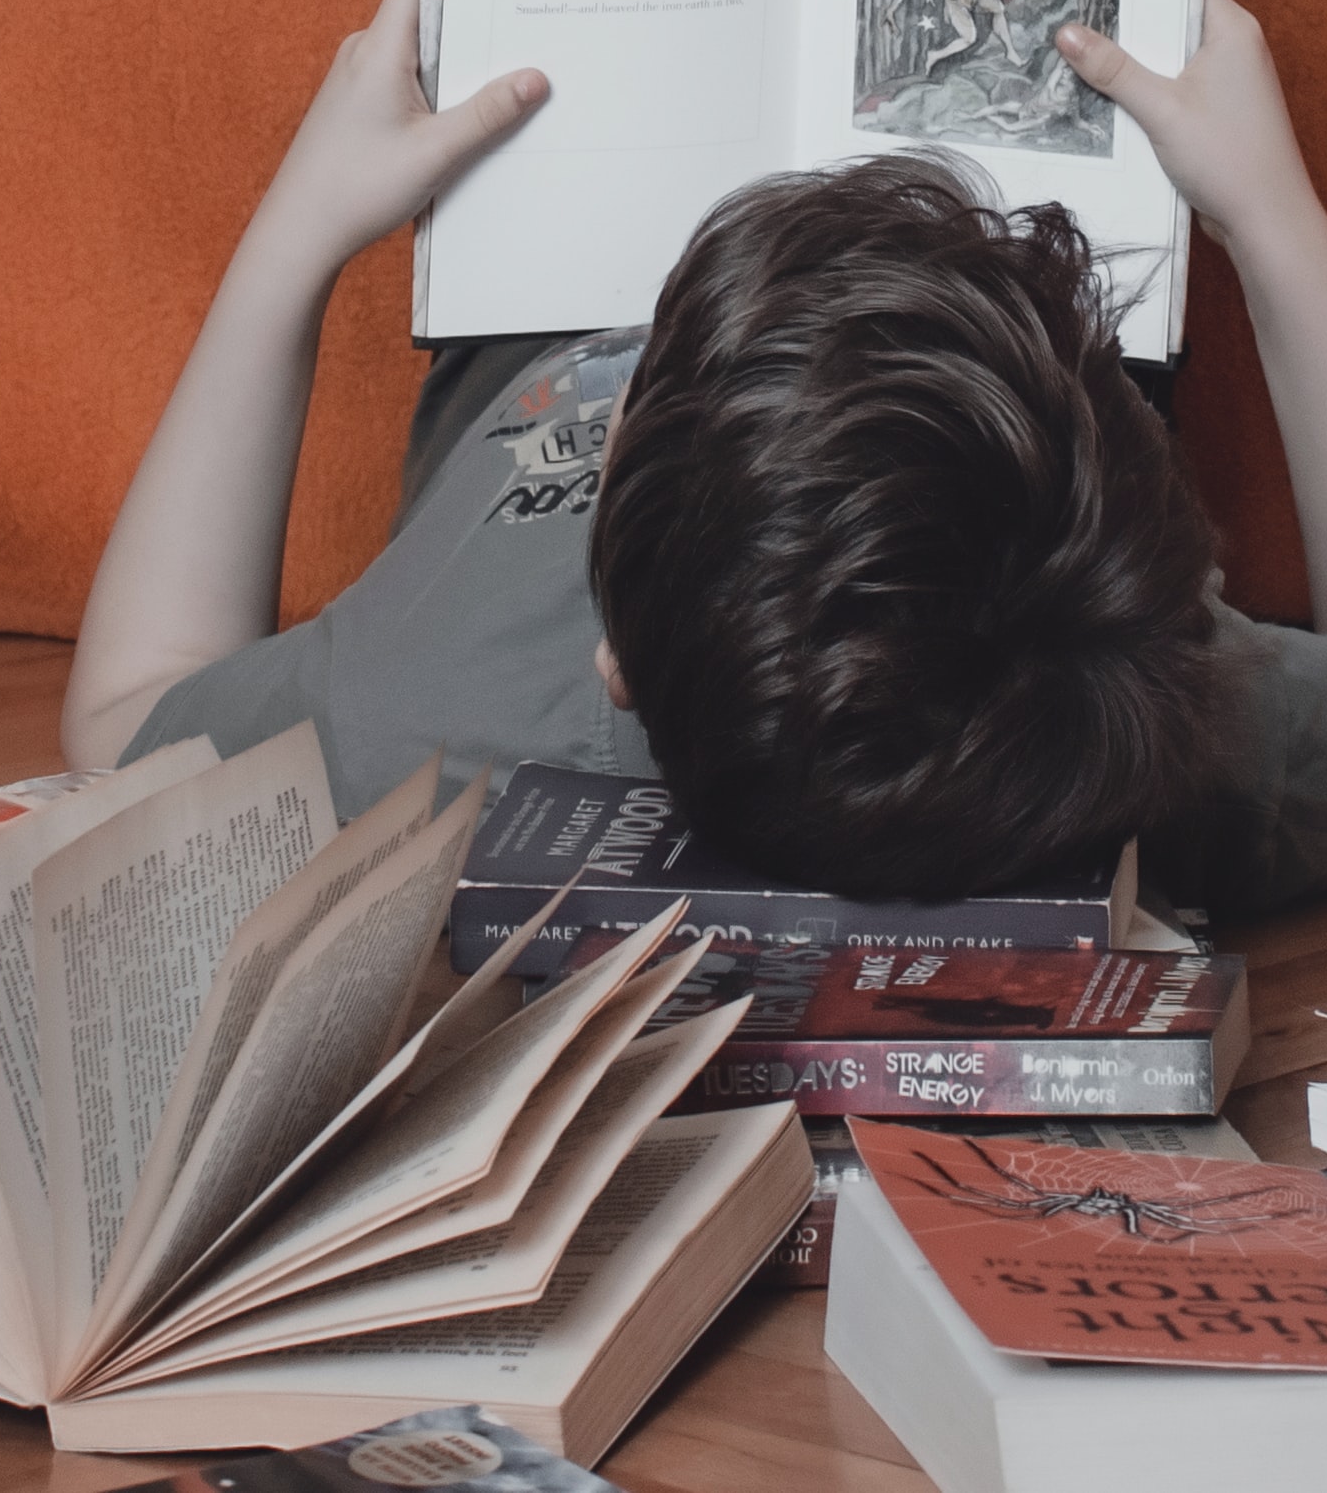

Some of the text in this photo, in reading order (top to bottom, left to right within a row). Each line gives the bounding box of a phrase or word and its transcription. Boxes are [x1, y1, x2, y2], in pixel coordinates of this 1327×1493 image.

[601, 2, 639, 14] heaved
[642, 1, 659, 12] the
[662, 0, 682, 11] iron
[547, 797, 605, 856] MARGARET
[583, 787, 672, 877] ATWOOD
[847, 934, 1014, 948] ORYX AND CRAKE
[886, 1052, 985, 1074] STRANGE
[1022, 1053, 1118, 1078] Benjamin
[703, 1057, 866, 1096] TUESDAYS:
[1143, 1066, 1195, 1086] Orion
[899, 1076, 985, 1107] ENERGY
[1030, 1083, 1116, 1106] J. Myers
